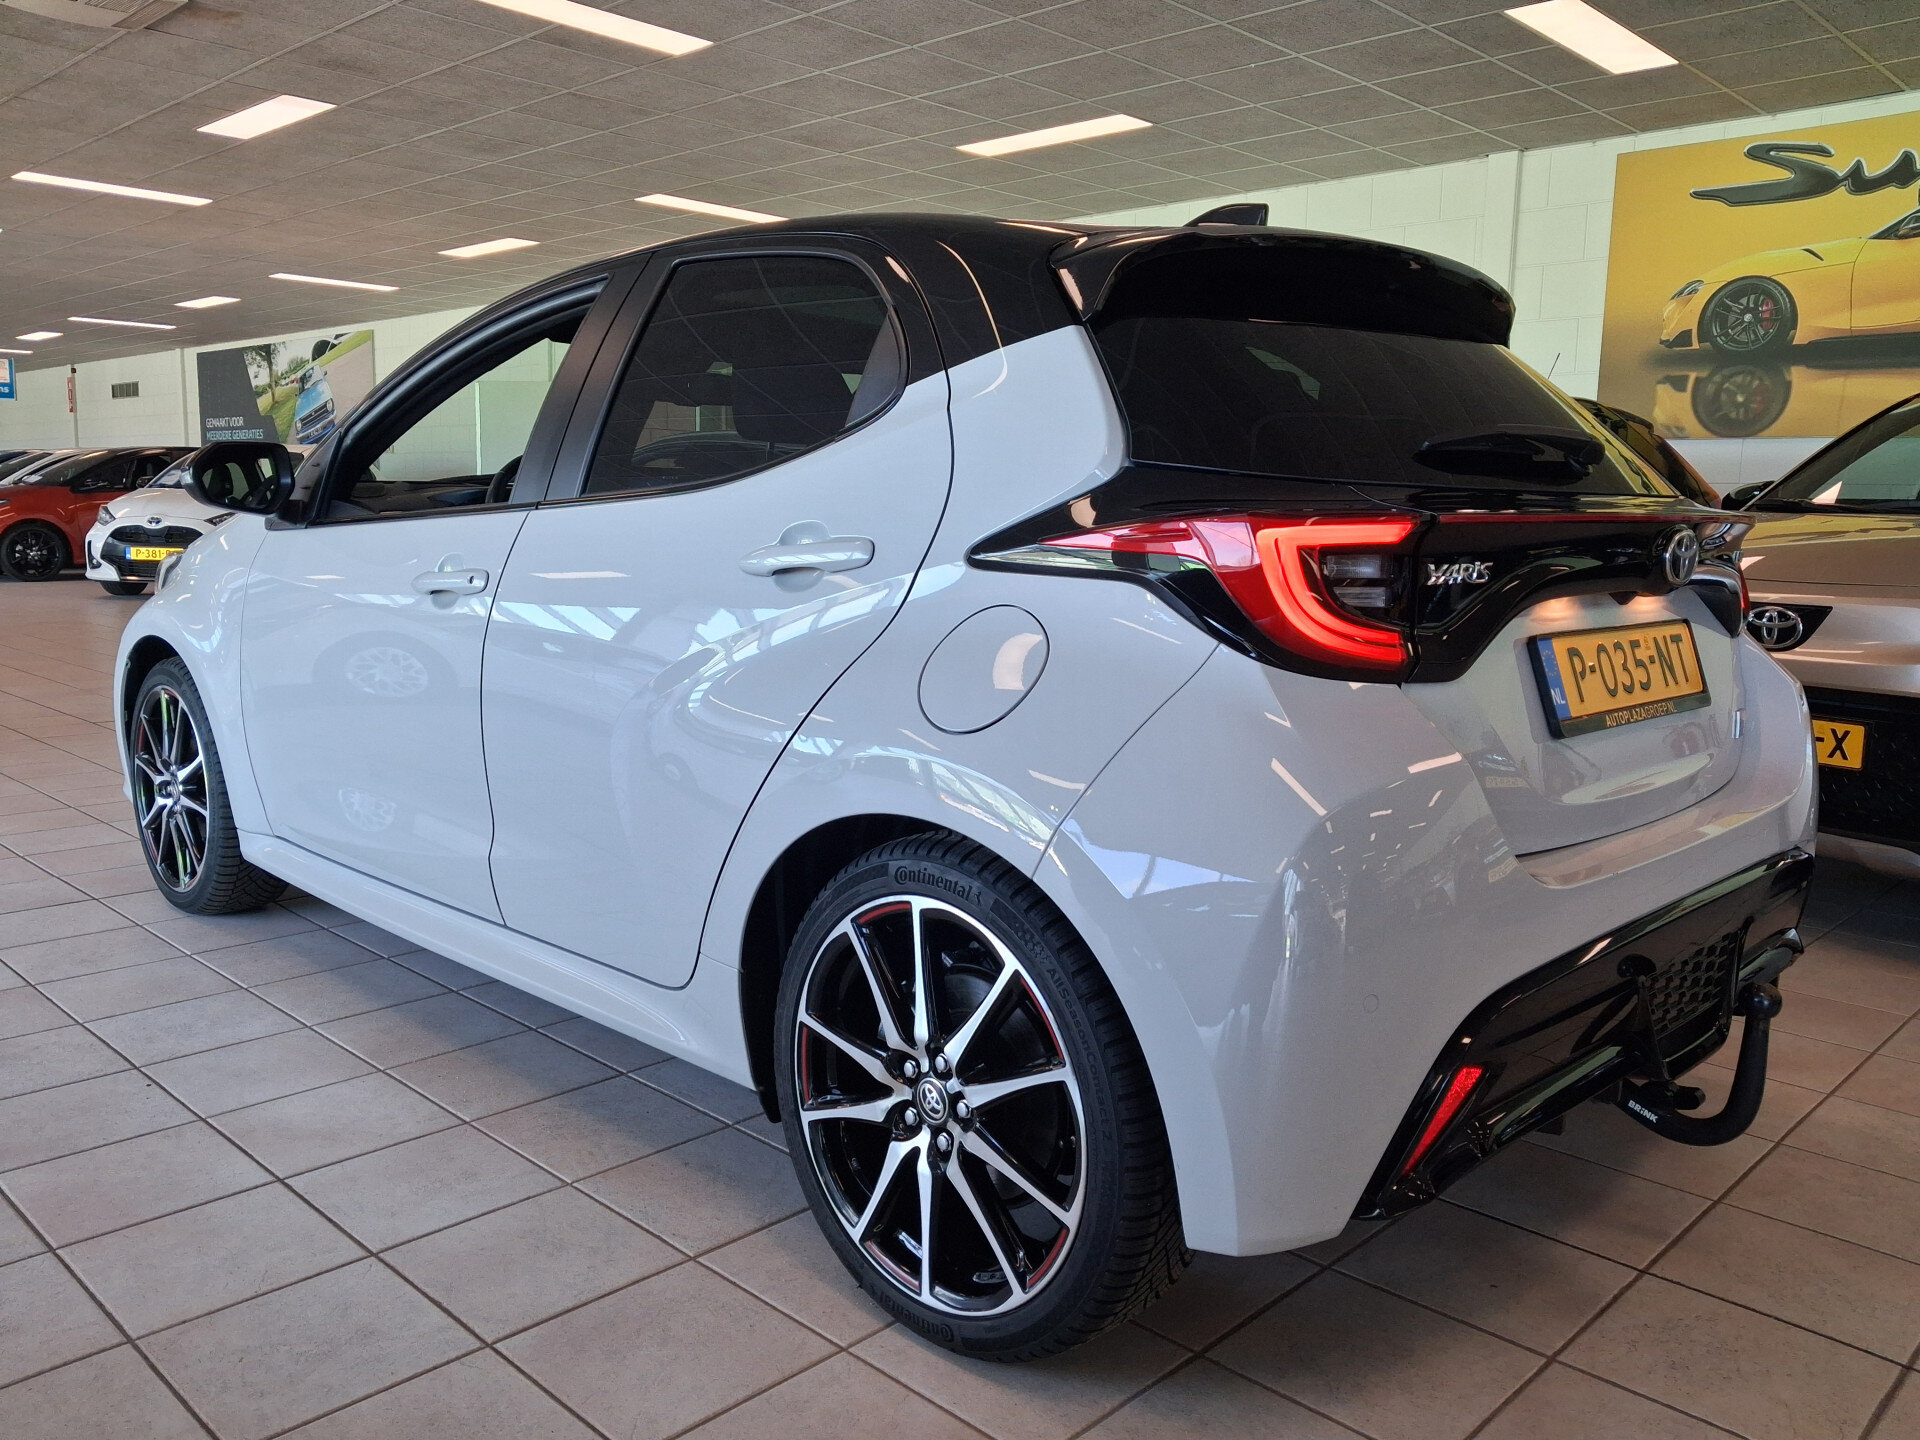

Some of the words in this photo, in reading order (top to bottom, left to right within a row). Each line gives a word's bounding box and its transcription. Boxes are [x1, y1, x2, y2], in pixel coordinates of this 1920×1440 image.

[1690, 142, 1920, 206] Su
[205, 418, 228, 428] GEMAAKT
[229, 417, 244, 427] VOOR
[206, 430, 232, 440] MEERDERE
[232, 429, 264, 440] GENERATIES
[1426, 561, 1494, 586] YARIS
[1567, 633, 1690, 703] P-035-NT
[1551, 688, 1566, 706] NL
[894, 865, 973, 901] Continental
